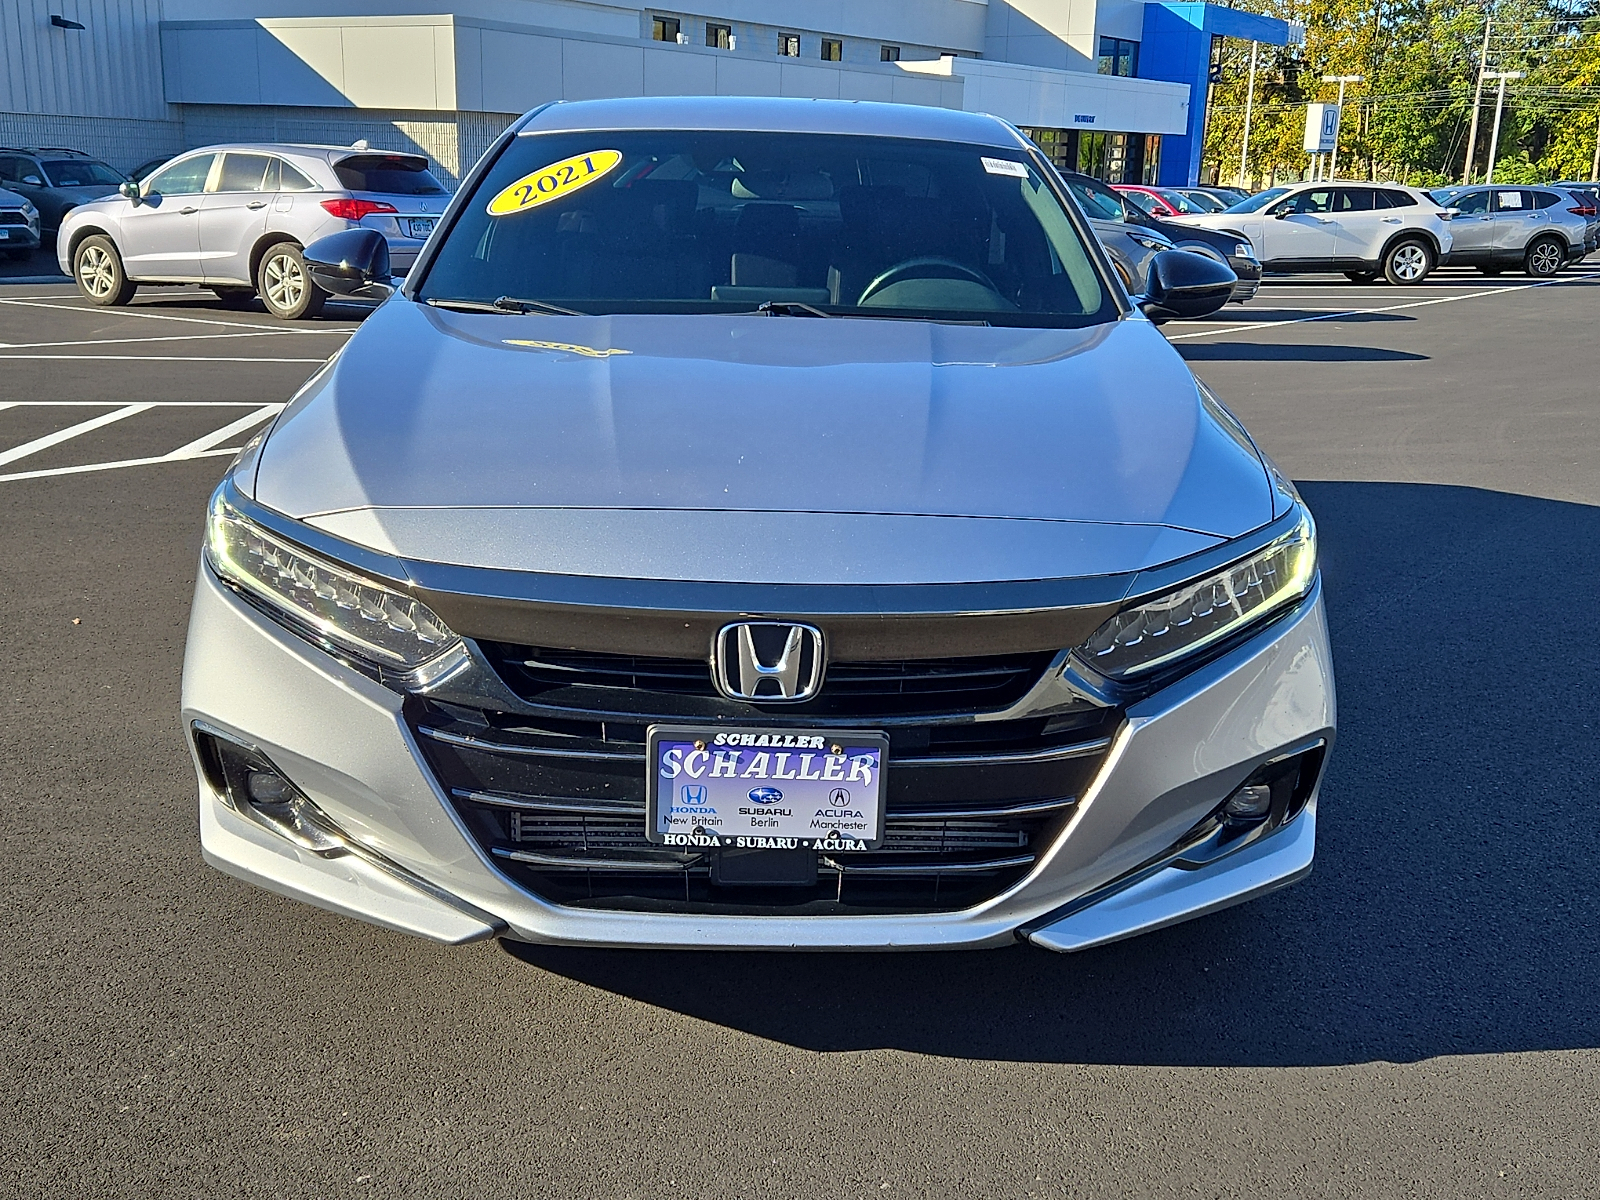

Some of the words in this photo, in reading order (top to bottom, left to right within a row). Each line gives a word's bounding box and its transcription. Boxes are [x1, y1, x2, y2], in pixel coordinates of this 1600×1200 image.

[514, 156, 599, 206] 2021
[713, 732, 826, 750] SCHALLER
[660, 749, 879, 787] SCHALLER
[669, 806, 717, 815] HONDA
[738, 807, 792, 817] SUBARU
[814, 809, 864, 819] ACURA
[663, 816, 689, 826] New
[691, 816, 723, 827] Britain
[750, 817, 779, 828] Berlin
[809, 818, 868, 831] Manchester
[663, 833, 722, 847] HONDA
[736, 835, 799, 850] SUBARU
[812, 838, 868, 851] ACURA
